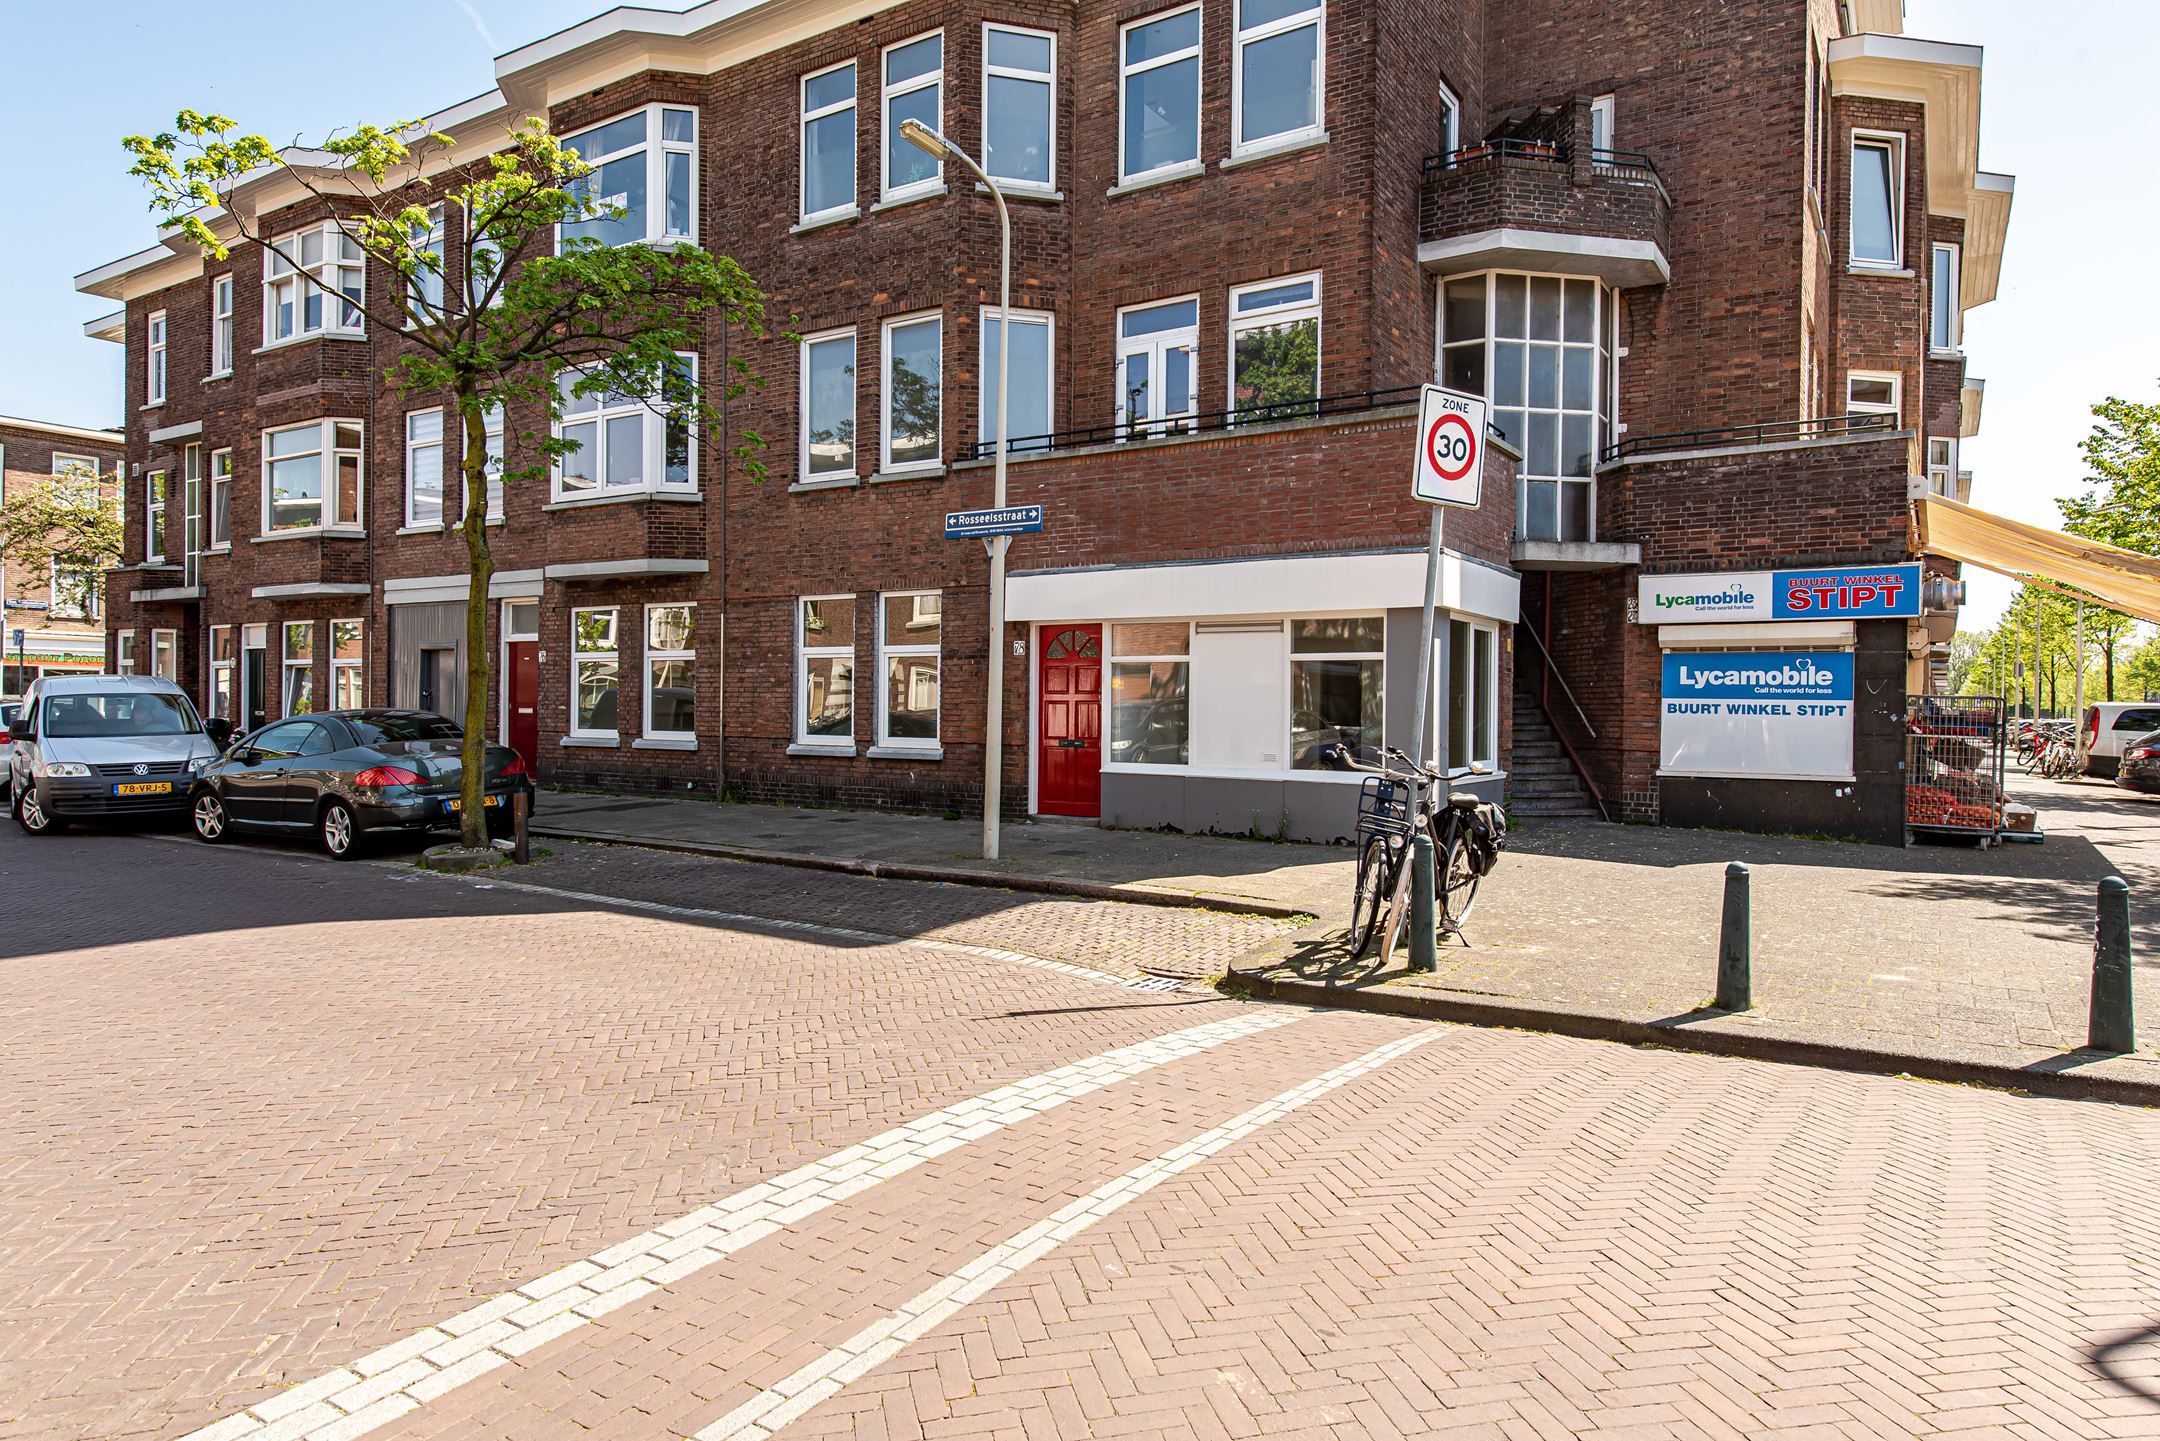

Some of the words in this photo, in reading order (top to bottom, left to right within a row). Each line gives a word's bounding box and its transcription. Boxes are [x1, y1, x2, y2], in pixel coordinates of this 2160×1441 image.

[1442, 398, 1469, 413] ZONE
[1437, 434, 1467, 462] 30
[958, 510, 1026, 525] Rosseelsstraat
[1789, 577, 1838, 587] BUURT
[1843, 574, 1904, 585] WINKEL
[1655, 590, 1755, 609] Lycamobile
[1786, 584, 1904, 611] STIPT
[1014, 641, 1025, 655] 78
[1680, 666, 1834, 689] Lycamobile
[1667, 703, 1721, 714] BUURT
[1727, 703, 1791, 716] WINKEL
[1797, 704, 1847, 717] STIPT
[122, 784, 168, 793] 78-VRJ-5
